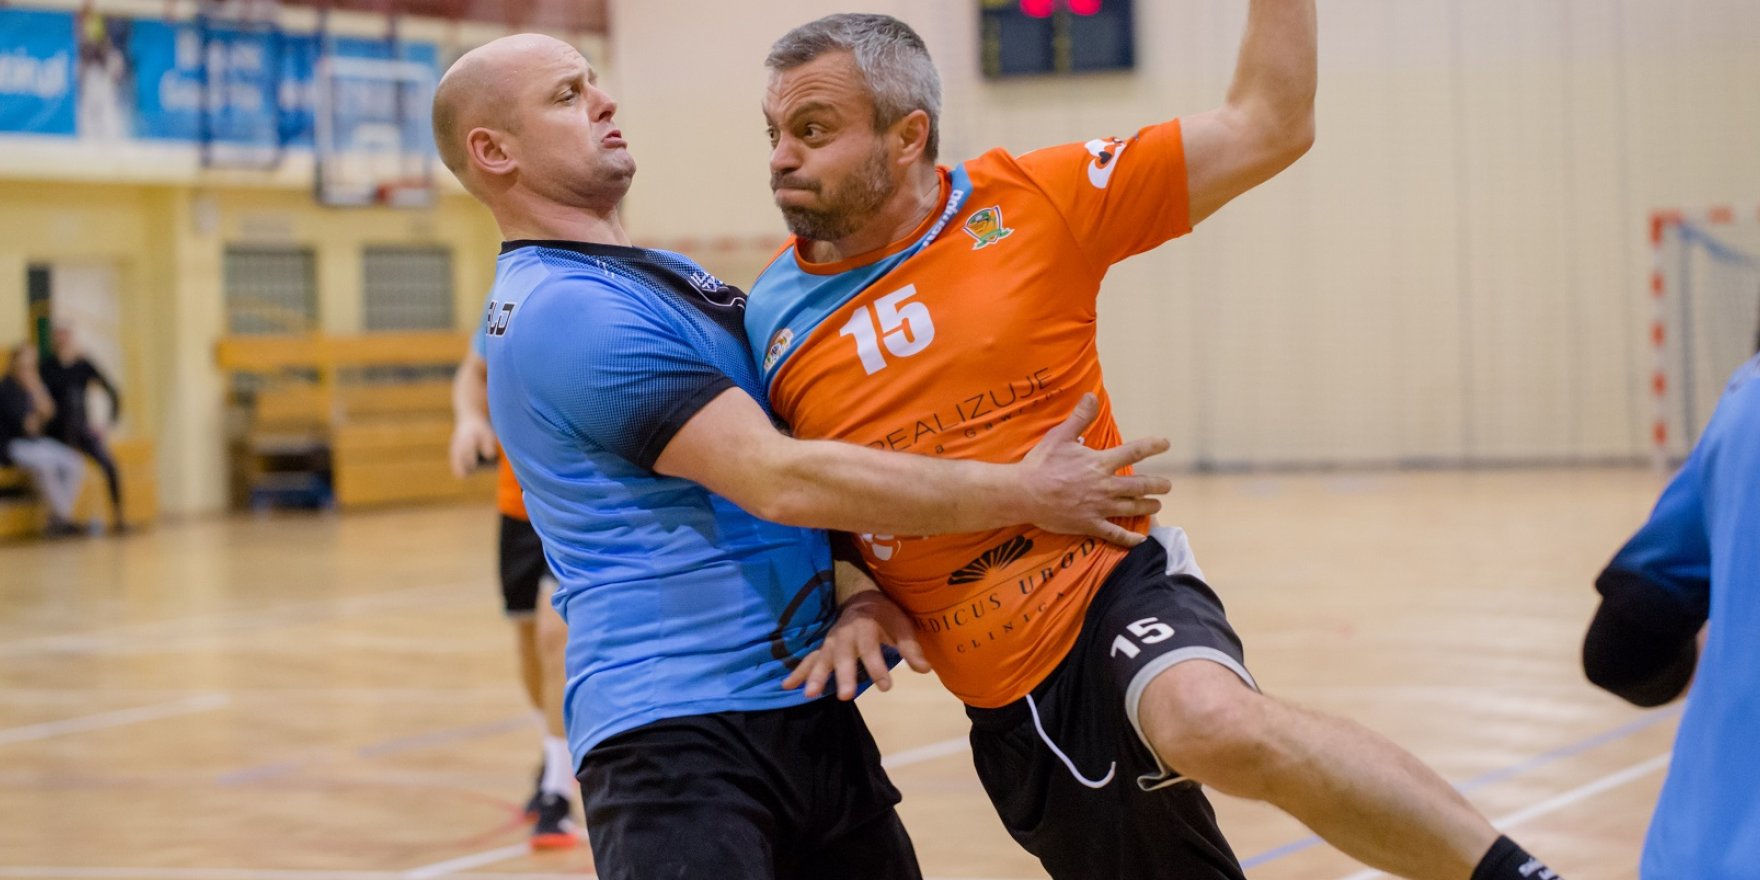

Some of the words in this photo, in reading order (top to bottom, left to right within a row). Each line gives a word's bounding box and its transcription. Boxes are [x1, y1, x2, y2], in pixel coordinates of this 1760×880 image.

[839, 283, 936, 375] 15
[955, 591, 1066, 655] CLINICA
[1110, 616, 1176, 660] 15
